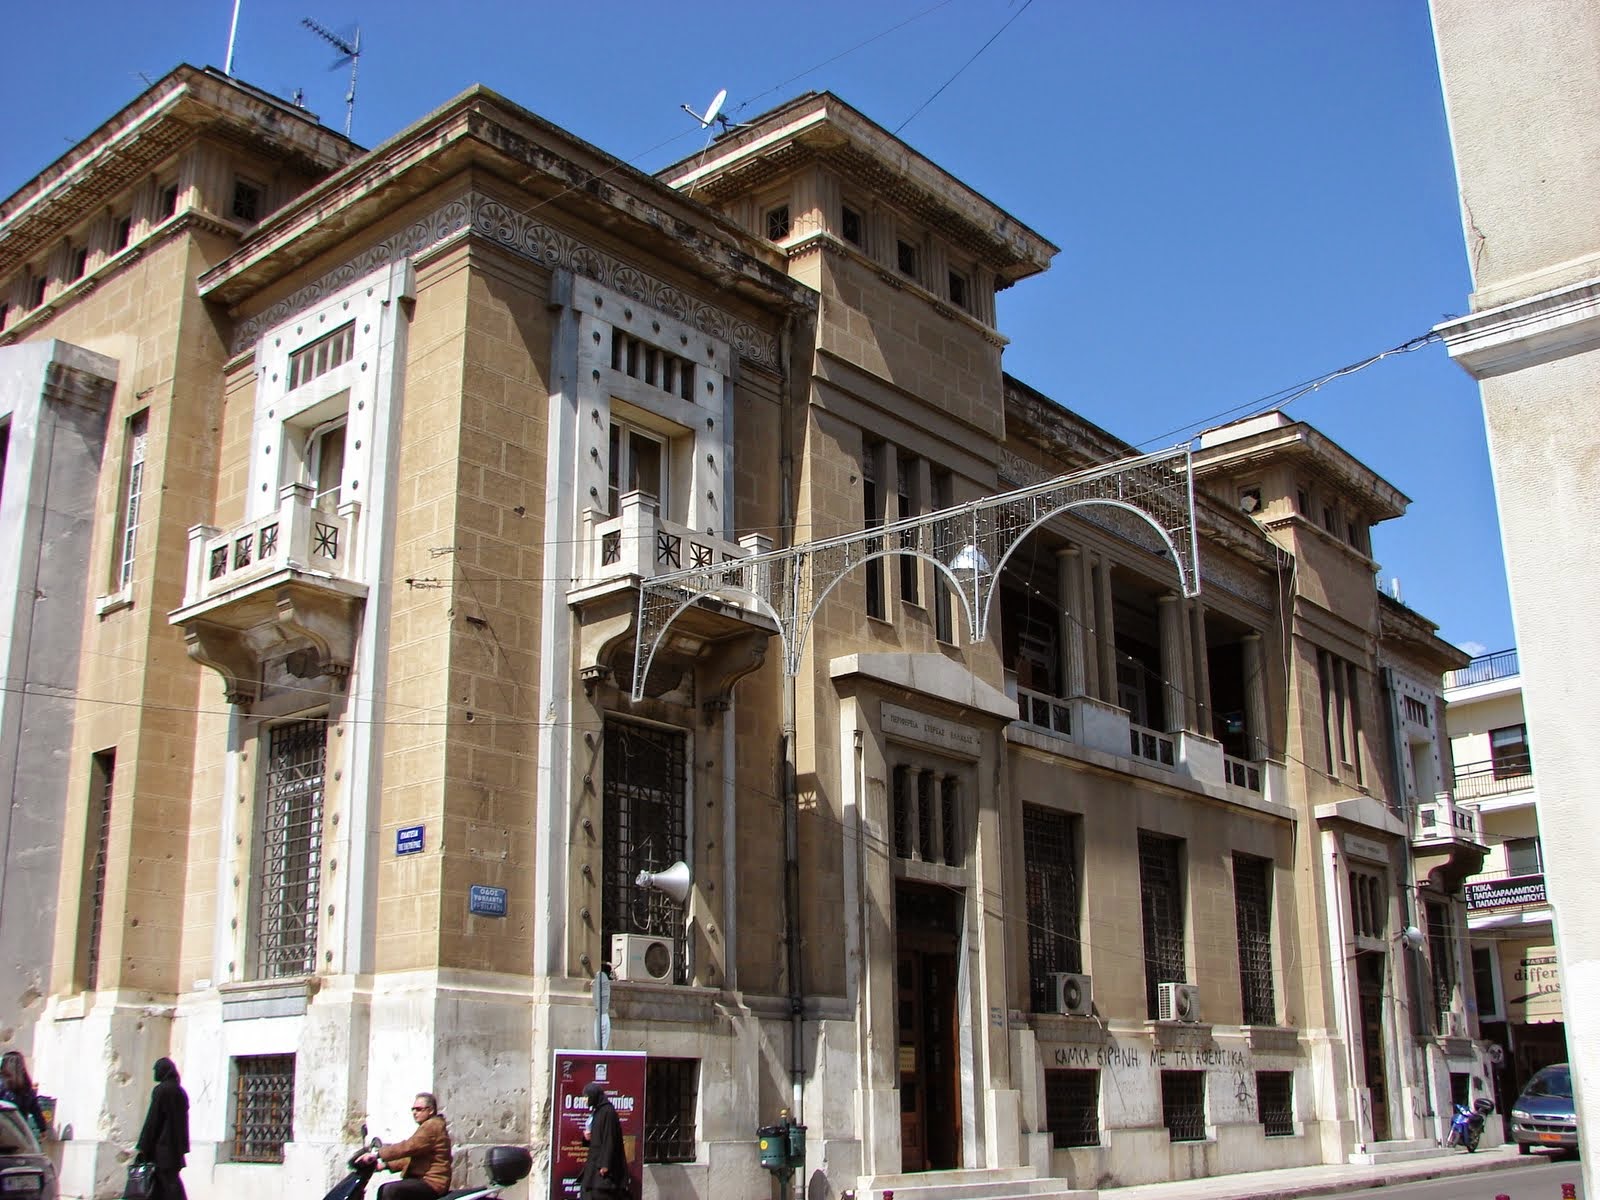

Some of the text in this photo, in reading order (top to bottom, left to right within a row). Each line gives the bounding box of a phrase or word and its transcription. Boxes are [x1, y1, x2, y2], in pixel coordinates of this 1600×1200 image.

[480, 888, 497, 896] ΟΔΟΣ
[1472, 883, 1492, 893] ΓΚΙΚΑ
[1473, 884, 1545, 900] ΠΑΠΑΧΑΡΑΛΑΜΠΟΥΣ
[1475, 892, 1546, 908] ΠΑΠΑΧΑΡΑΛΑΜΠΟΥΣ
[1054, 1047, 1090, 1067] ΚΑΜΙΑ
[1150, 1048, 1166, 1067] ΜΕ
[1174, 1050, 1188, 1067] ΤΑ
[1195, 1049, 1245, 1068] ΑΦΕΝΤΙΚΑ
[565, 1094, 572, 1109] Ο
